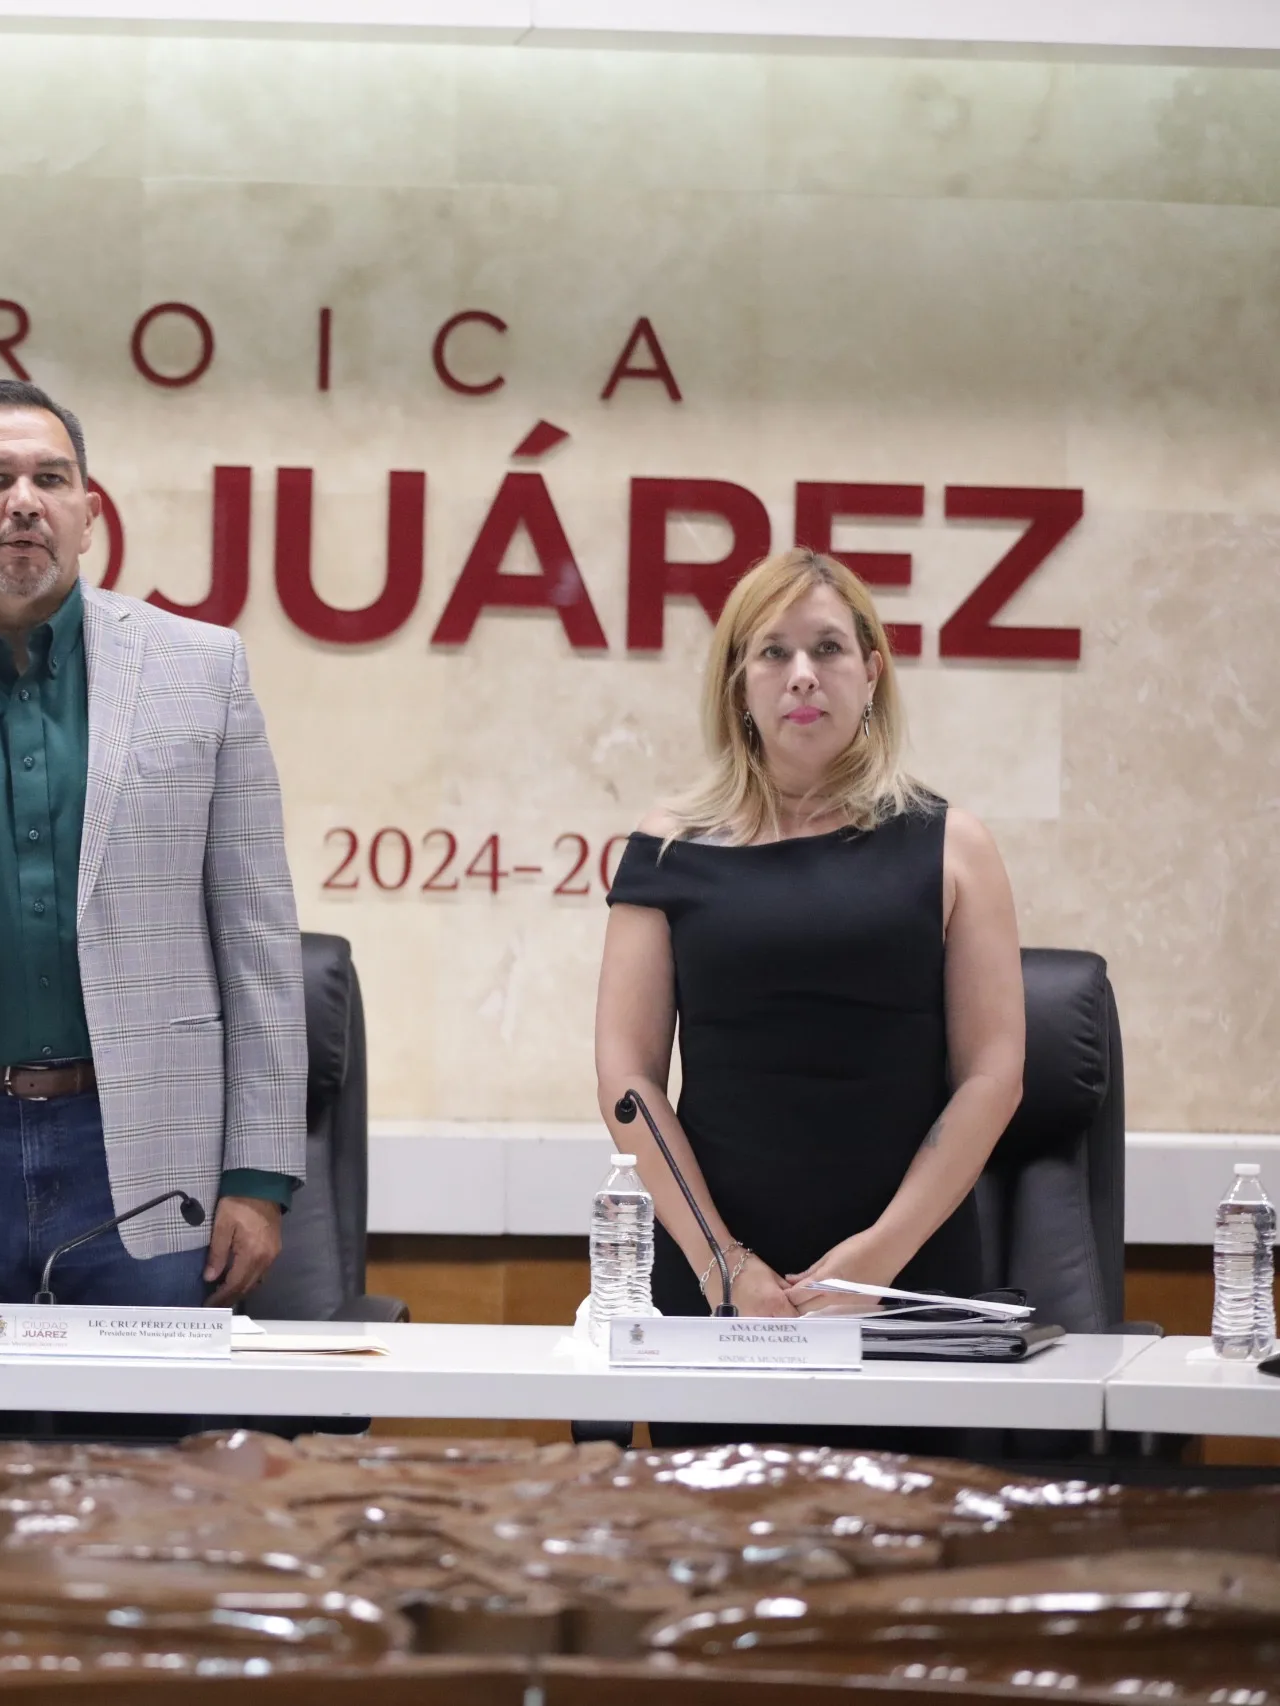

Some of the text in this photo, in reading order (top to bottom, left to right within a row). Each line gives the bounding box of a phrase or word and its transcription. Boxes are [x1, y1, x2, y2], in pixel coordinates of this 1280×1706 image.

[150, 419, 1085, 660] JUÁREZ
[322, 826, 628, 897] 2024-2
[21, 1320, 69, 1330] CIUDAD
[88, 1319, 108, 1328] LIC.
[110, 1320, 138, 1328] CRUZ
[141, 1318, 173, 1329] PÉREZ
[730, 1323, 798, 1333] ANA CARMEN
[21, 1329, 68, 1339] JUÁREZ
[99, 1329, 137, 1337] Presidente
[139, 1330, 176, 1339] Municipal
[719, 1334, 766, 1343] ESTRADA
